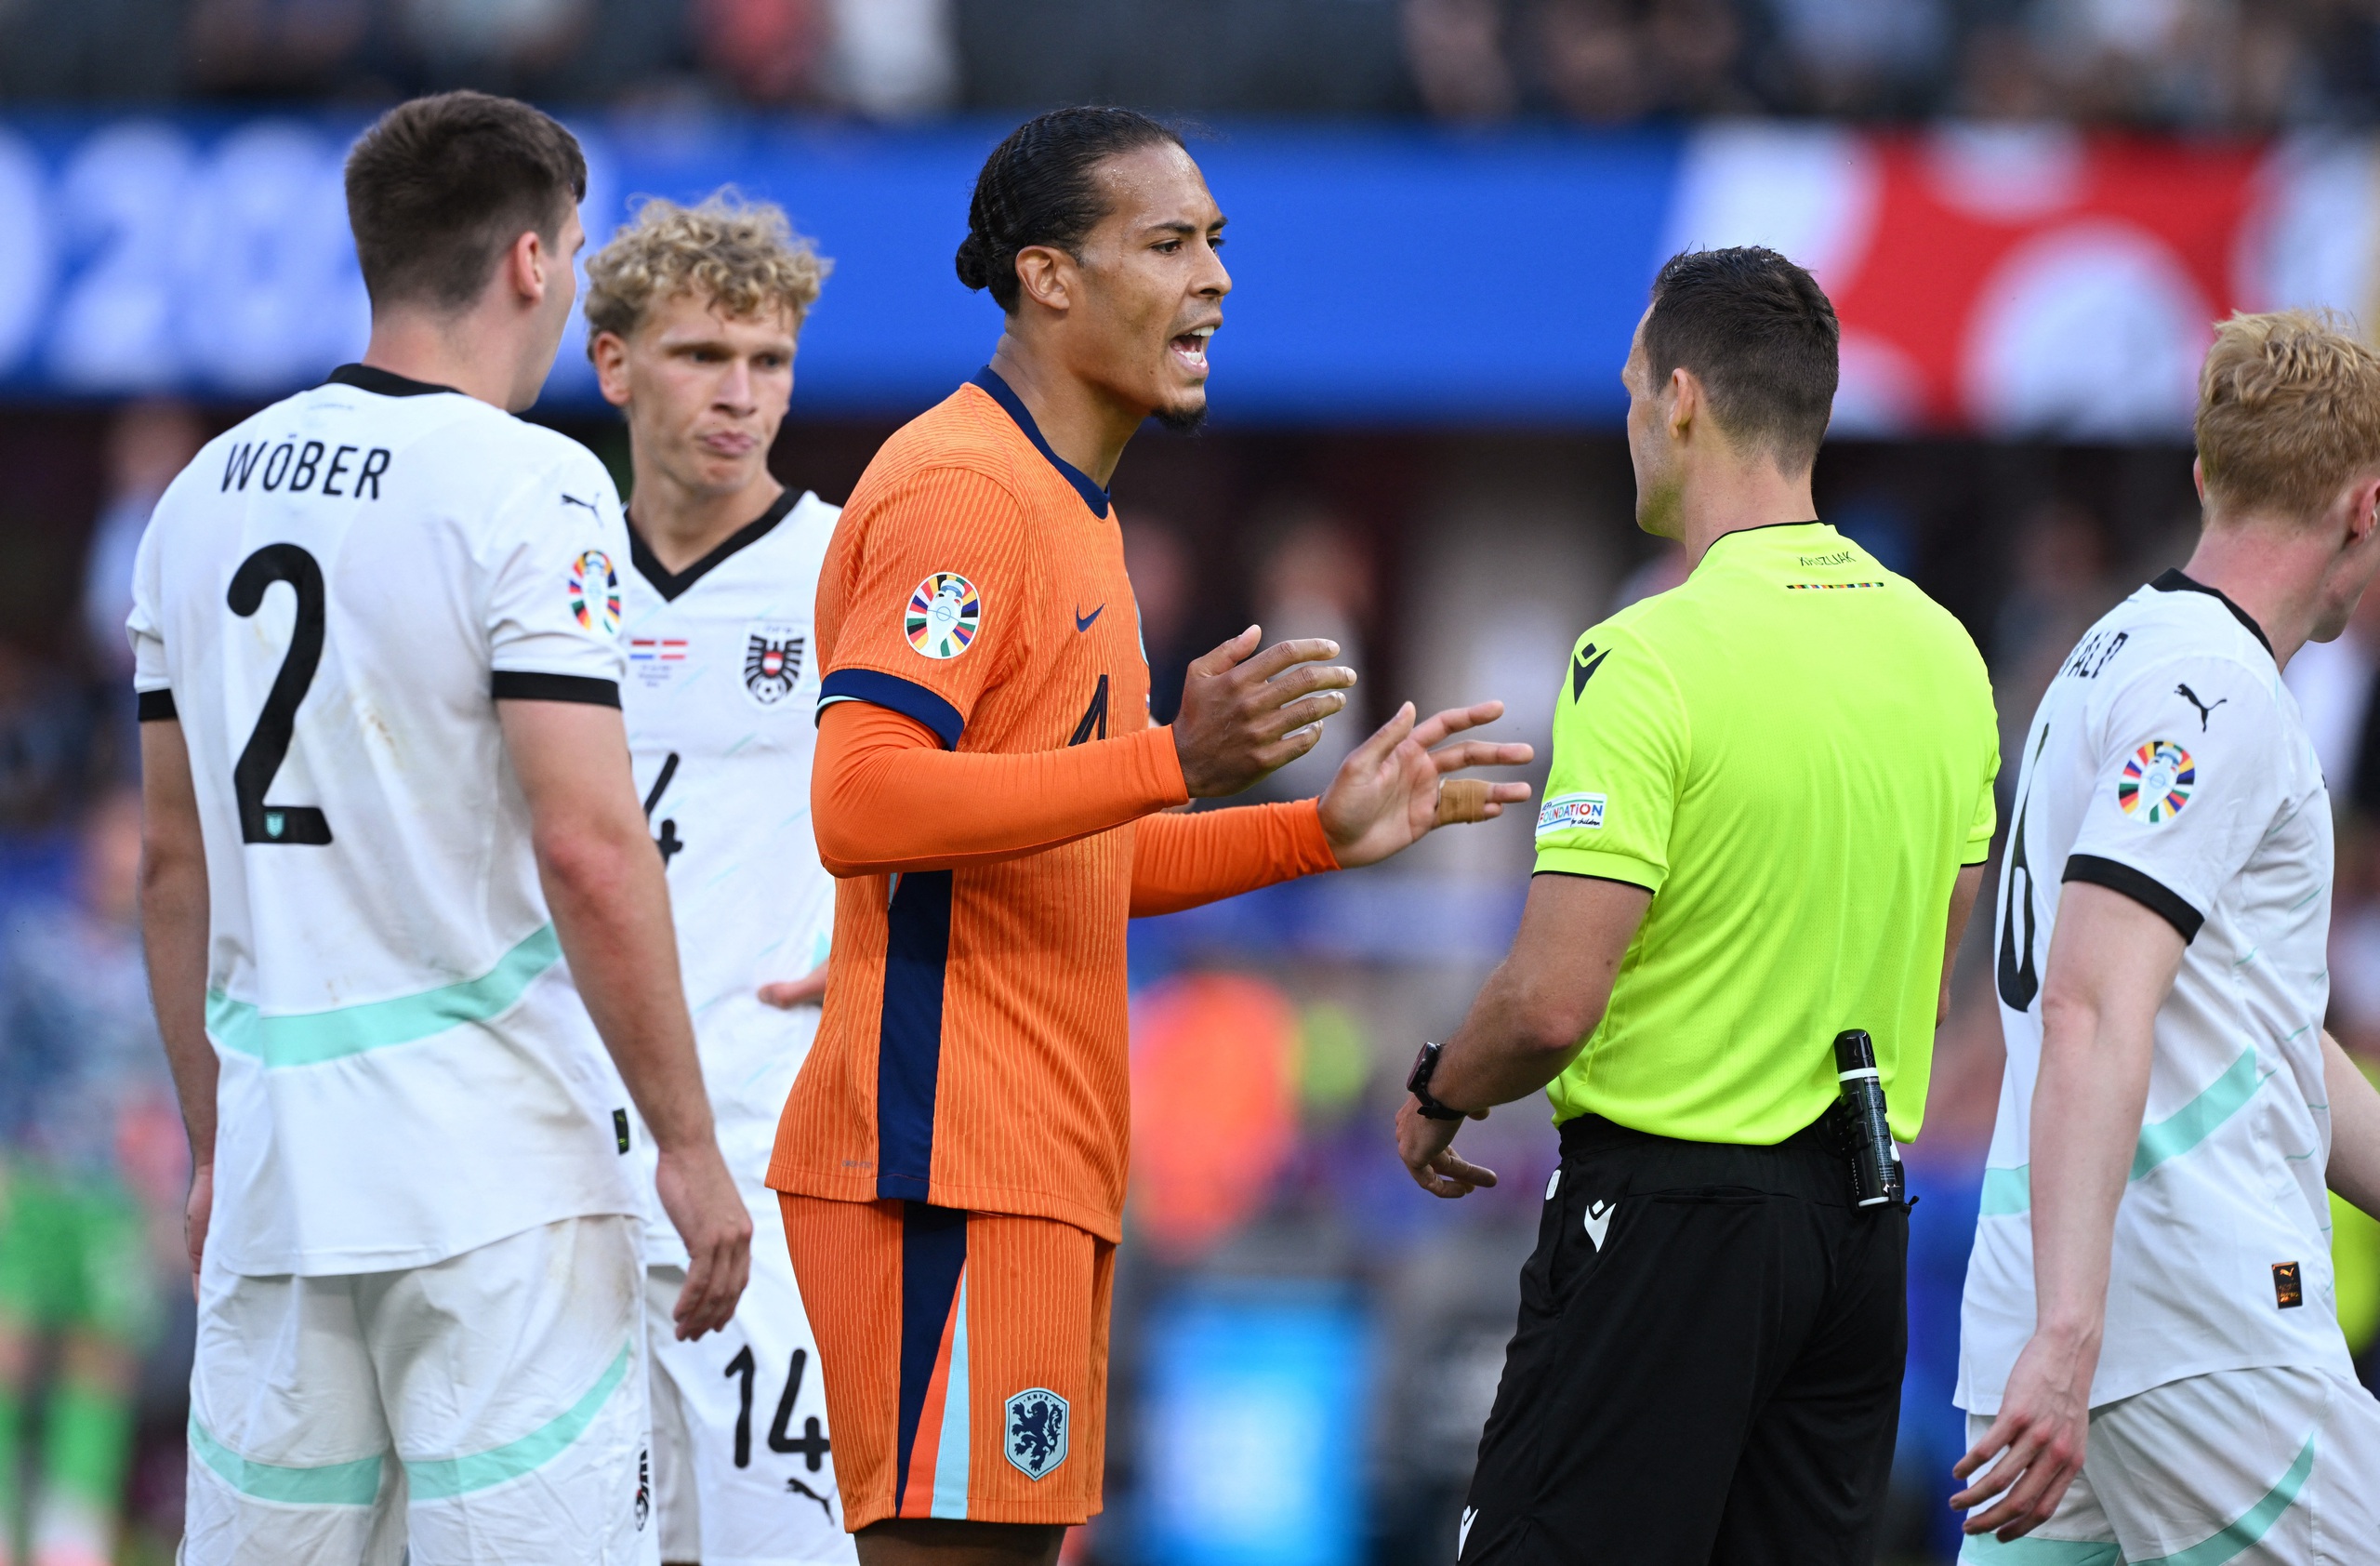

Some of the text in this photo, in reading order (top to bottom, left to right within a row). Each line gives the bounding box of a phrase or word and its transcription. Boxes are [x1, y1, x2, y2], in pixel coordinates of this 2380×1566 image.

[221, 433, 390, 500] WÖBER
[227, 542, 333, 845] 2
[628, 751, 683, 869] 4
[724, 1345, 831, 1472] 14
